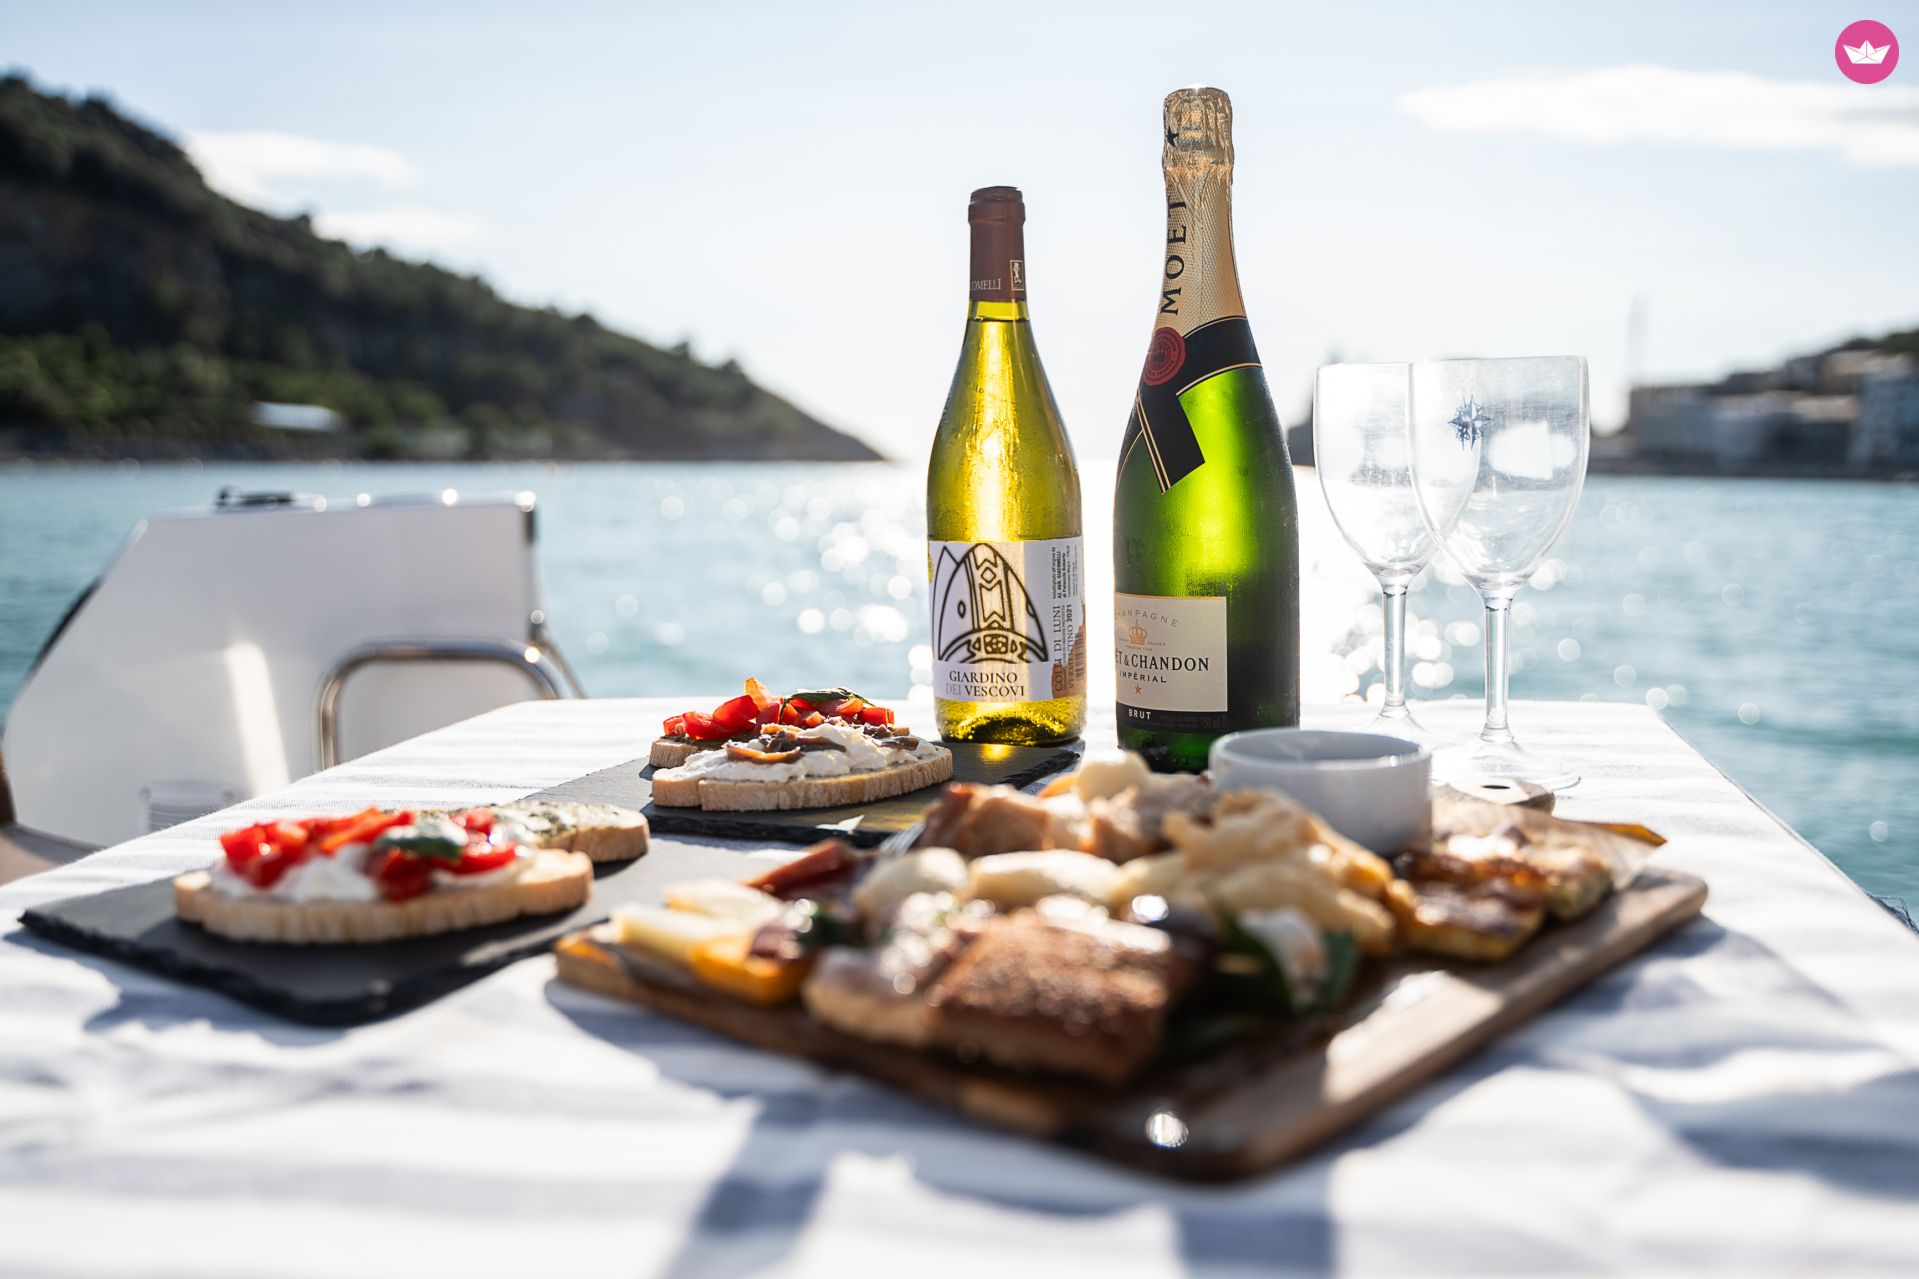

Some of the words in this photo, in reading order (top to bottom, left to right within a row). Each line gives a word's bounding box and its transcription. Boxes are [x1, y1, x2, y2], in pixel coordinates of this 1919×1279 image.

[1052, 605, 1061, 633] LUNI
[1053, 639, 1062, 652] DI
[1124, 655, 1130, 667] &
[1131, 653, 1209, 672] CHANDON
[949, 671, 1018, 684] GIARDINO
[1119, 670, 1167, 683] IMPÉRIAL
[945, 683, 962, 696] DEI
[964, 685, 1025, 697] VESCOVI
[1128, 708, 1152, 720] BRUT
